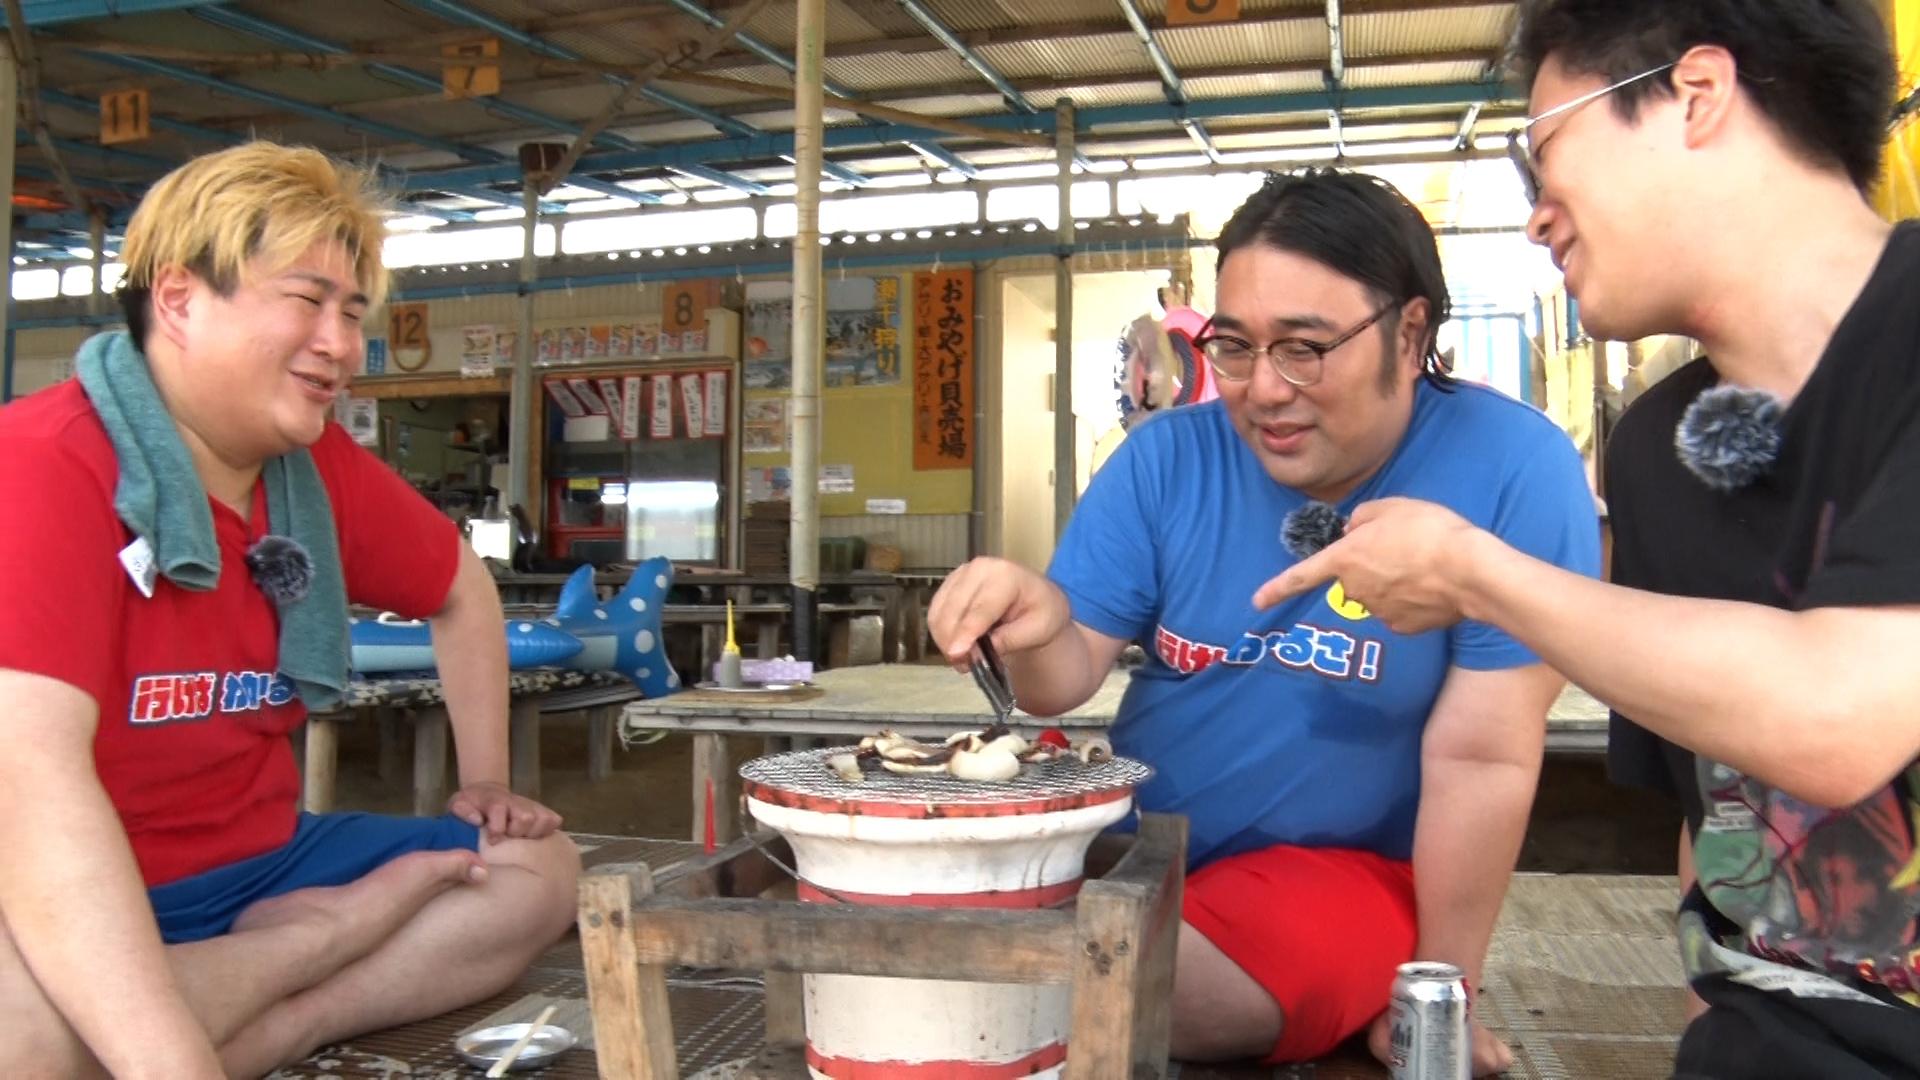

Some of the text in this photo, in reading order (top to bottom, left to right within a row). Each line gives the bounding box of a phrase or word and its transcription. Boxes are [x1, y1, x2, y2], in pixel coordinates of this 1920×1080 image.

[459, 45, 484, 91] 7
[109, 95, 144, 131] 11
[675, 291, 694, 326] 8
[391, 311, 422, 345] 12
[937, 278, 967, 459] おみやげ貝売場
